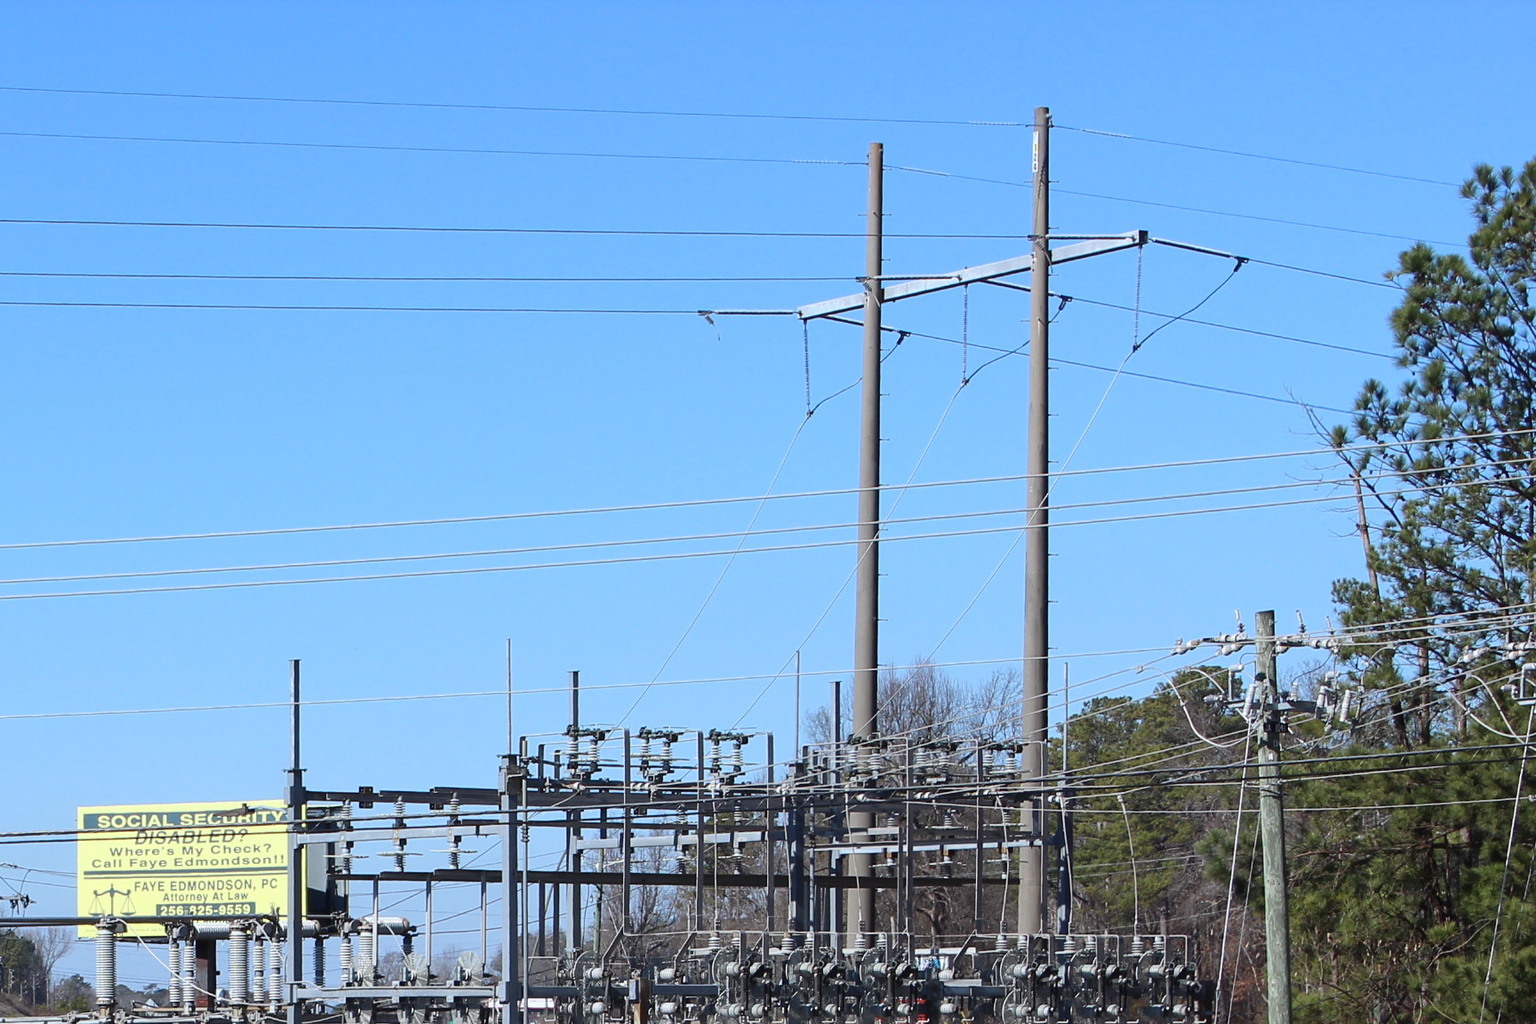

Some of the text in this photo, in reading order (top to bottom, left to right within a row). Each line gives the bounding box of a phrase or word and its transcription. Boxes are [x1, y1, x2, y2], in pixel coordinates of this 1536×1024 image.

[97, 813, 174, 829] SOCIAL
[135, 828, 248, 845] DISABLED?
[109, 843, 272, 857] Where's My Check?
[91, 854, 285, 870] Call Faye Edmondson!!
[134, 878, 278, 892] FAYE EDMONDSON, PC
[162, 891, 249, 904] Attorney At Law
[160, 904, 251, 916] 256825-9559
